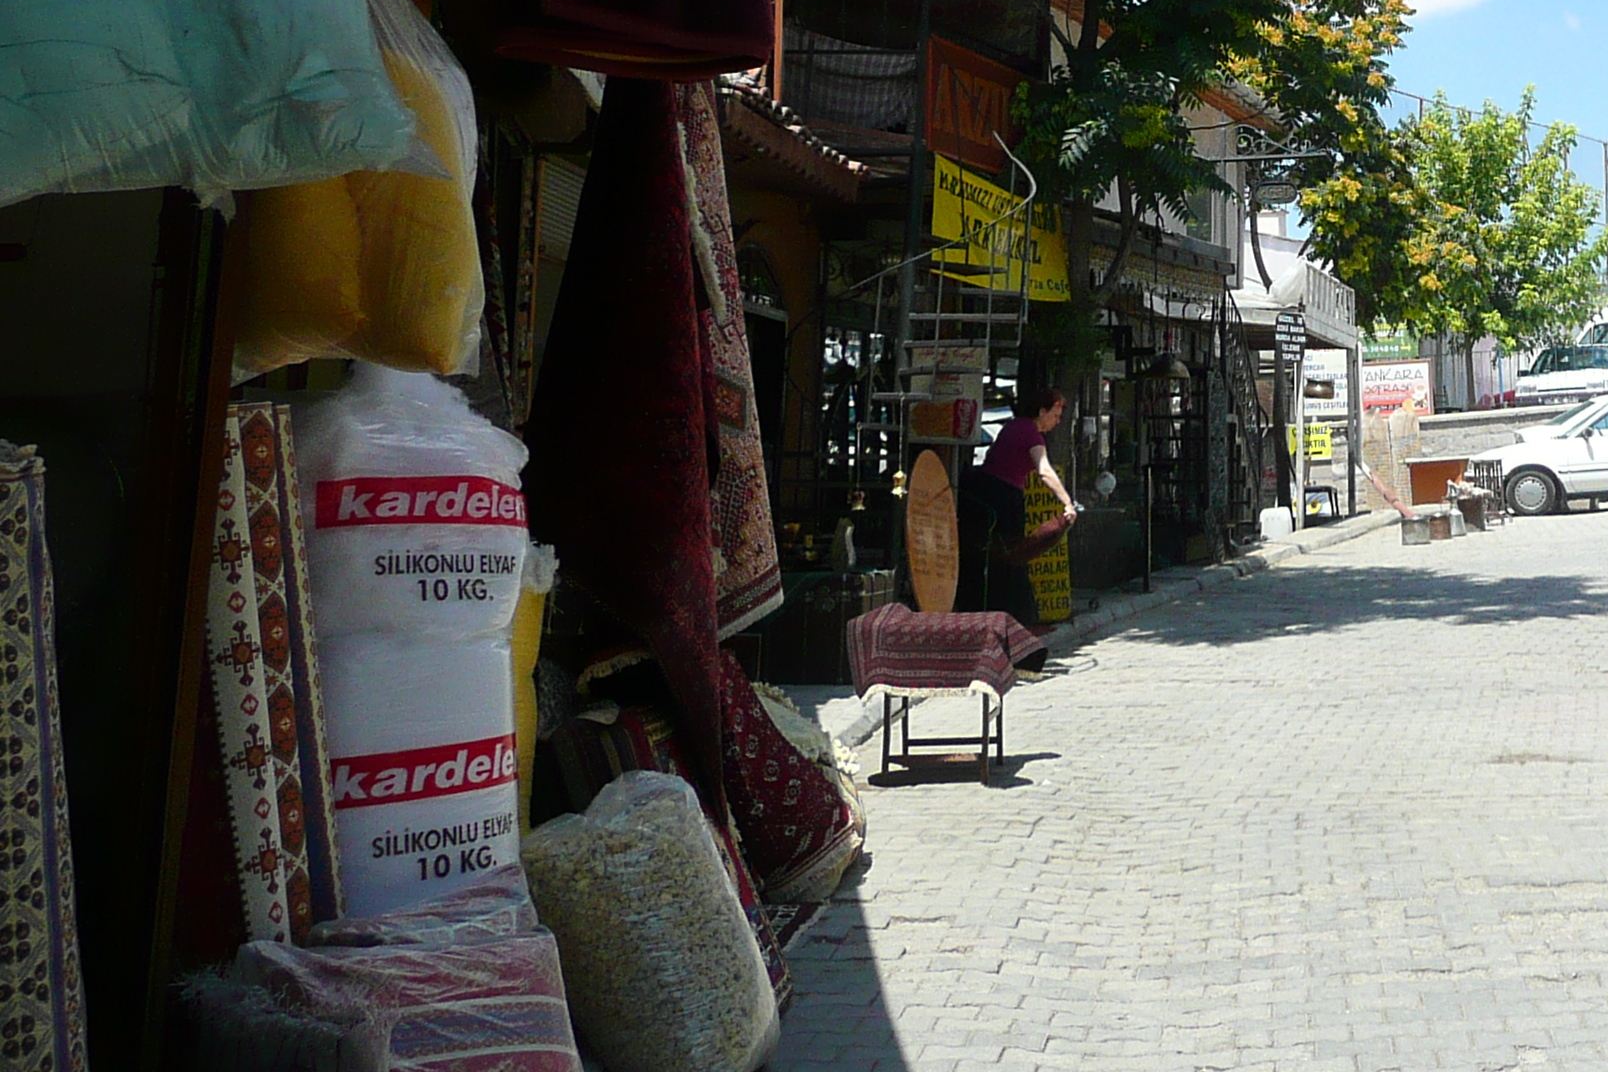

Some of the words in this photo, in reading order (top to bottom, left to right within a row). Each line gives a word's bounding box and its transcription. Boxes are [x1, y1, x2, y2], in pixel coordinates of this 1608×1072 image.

[1305, 401, 1322, 411] ÜMÜŞ
[1323, 401, 1348, 411] ÇEŞİTLE
[337, 482, 526, 522] kardelen
[374, 550, 475, 576] SİLİKONLU
[480, 554, 516, 575] ELYAF
[419, 579, 448, 601] 10
[458, 579, 495, 601] KG.
[371, 822, 478, 859] SİLİKONLU
[417, 854, 450, 881] 10
[460, 846, 497, 874] KG.
